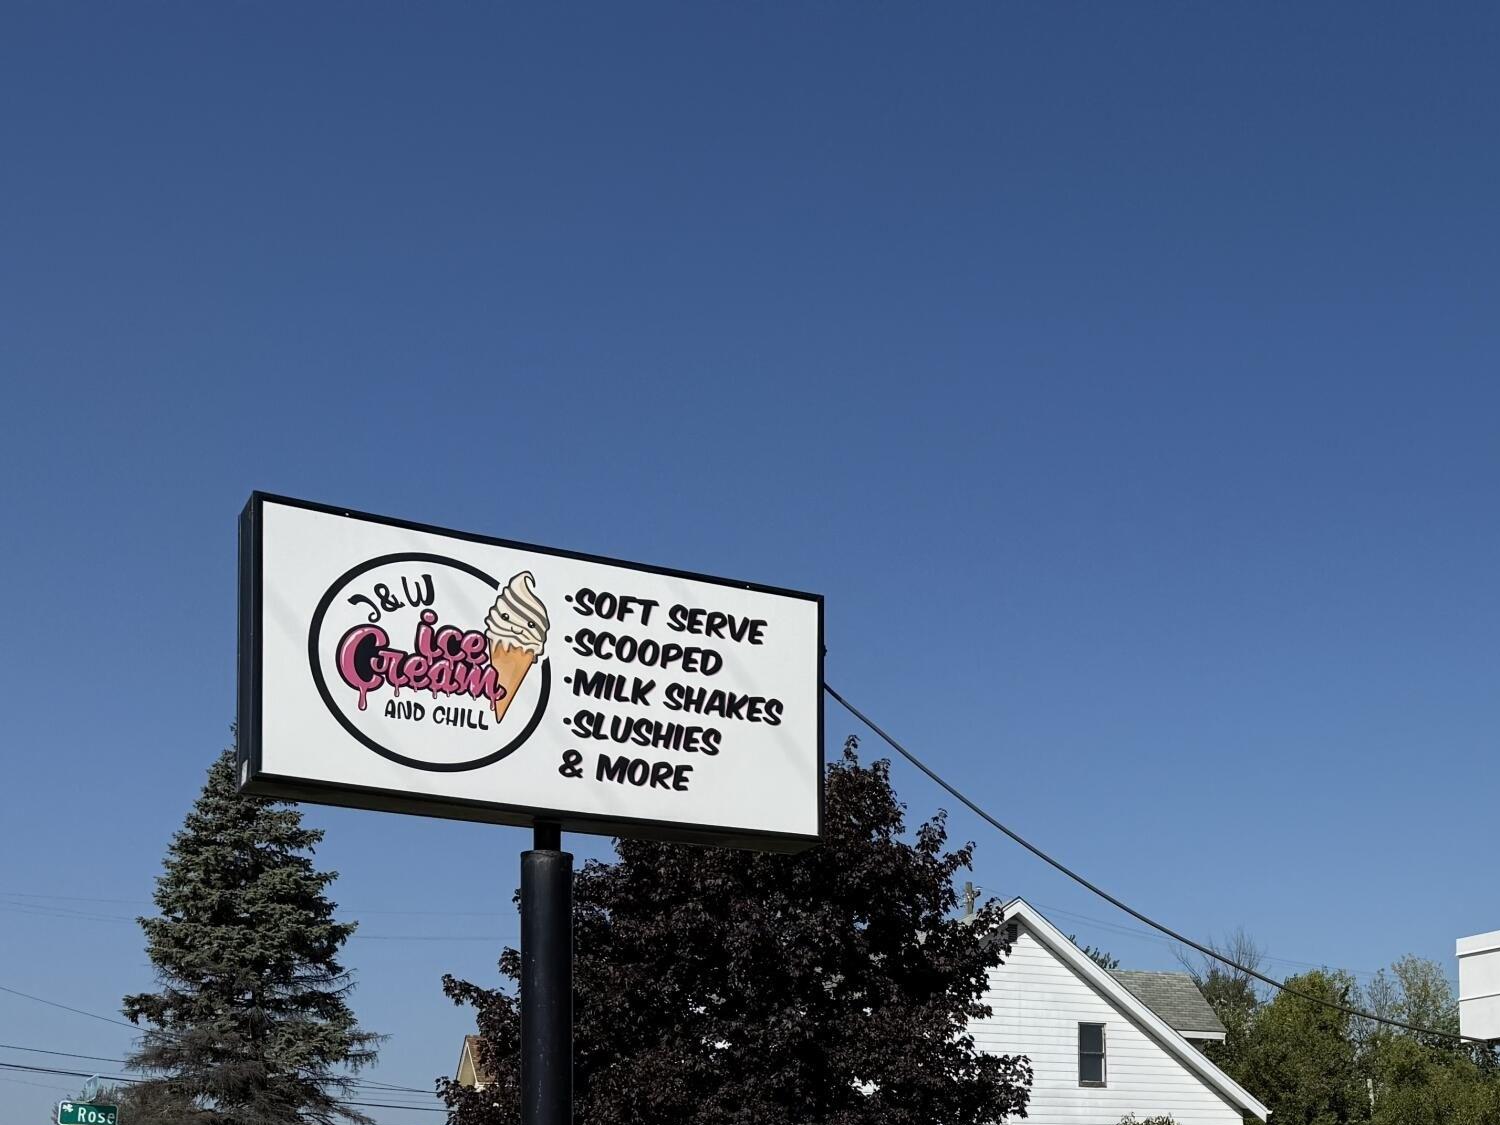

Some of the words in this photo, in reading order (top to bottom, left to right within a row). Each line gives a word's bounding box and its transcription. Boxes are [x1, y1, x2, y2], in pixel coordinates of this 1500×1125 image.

[347, 574, 435, 623] J&W
[414, 608, 489, 664] ice
[667, 604, 768, 645] SERVE
[336, 624, 507, 706] Cream
[384, 699, 425, 721] AND
[433, 706, 488, 730] CHILL
[663, 682, 784, 726] SHAKES
[558, 749, 583, 779] &
[595, 753, 694, 791] MORE
[77, 1106, 115, 1124] Rose
